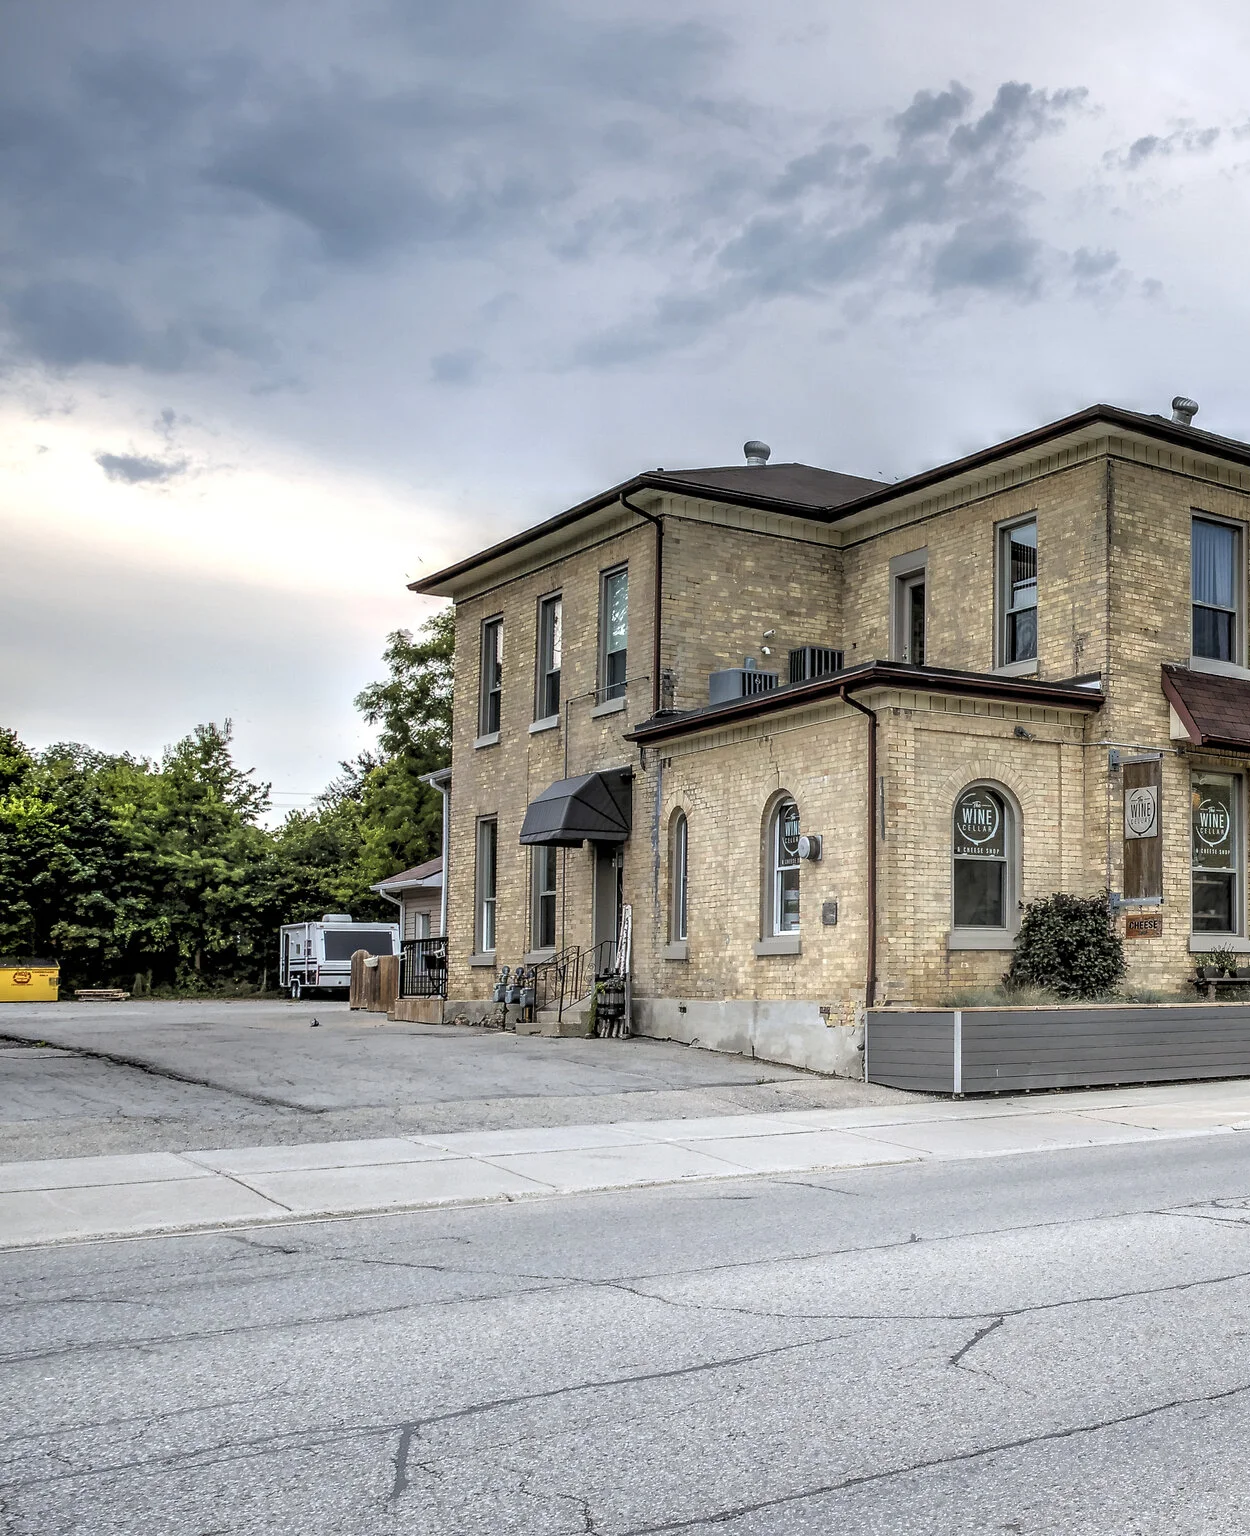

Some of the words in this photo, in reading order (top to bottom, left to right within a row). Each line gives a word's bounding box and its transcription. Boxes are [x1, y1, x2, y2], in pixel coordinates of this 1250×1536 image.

[962, 808, 992, 825] WINE
[1131, 802, 1151, 818] WINE
[1200, 812, 1224, 828] WINE
[1129, 920, 1158, 929] CHEESE
